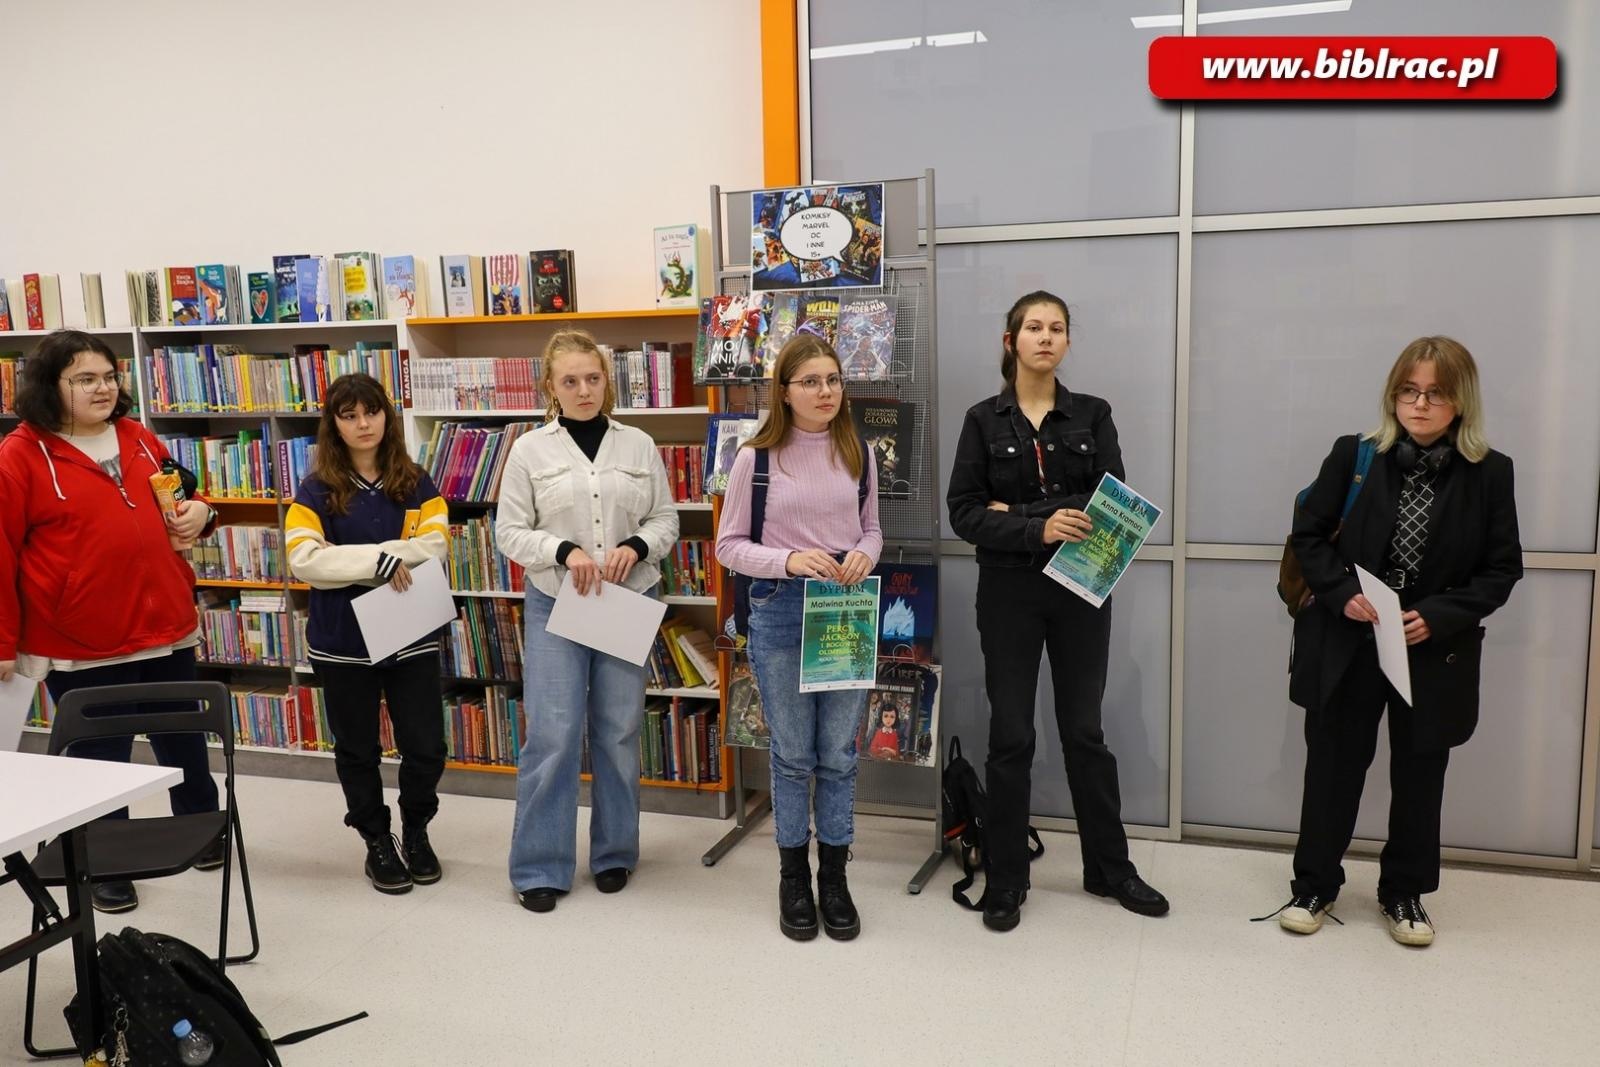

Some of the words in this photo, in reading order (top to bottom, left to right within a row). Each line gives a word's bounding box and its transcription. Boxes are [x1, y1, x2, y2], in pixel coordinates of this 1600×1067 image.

[801, 212, 831, 220] KOMIKSY
[843, 302, 888, 314] SPIDER-MAN
[402, 358, 411, 400] MANGA
[1100, 499, 1119, 516] Anna
[1111, 487, 1149, 518] DYPLOM
[819, 584, 865, 594] DYPLOM
[811, 600, 843, 609] Malwina
[845, 599, 873, 607] Kuchta
[826, 624, 855, 634] PERCY
[819, 633, 860, 642] JACKSON
